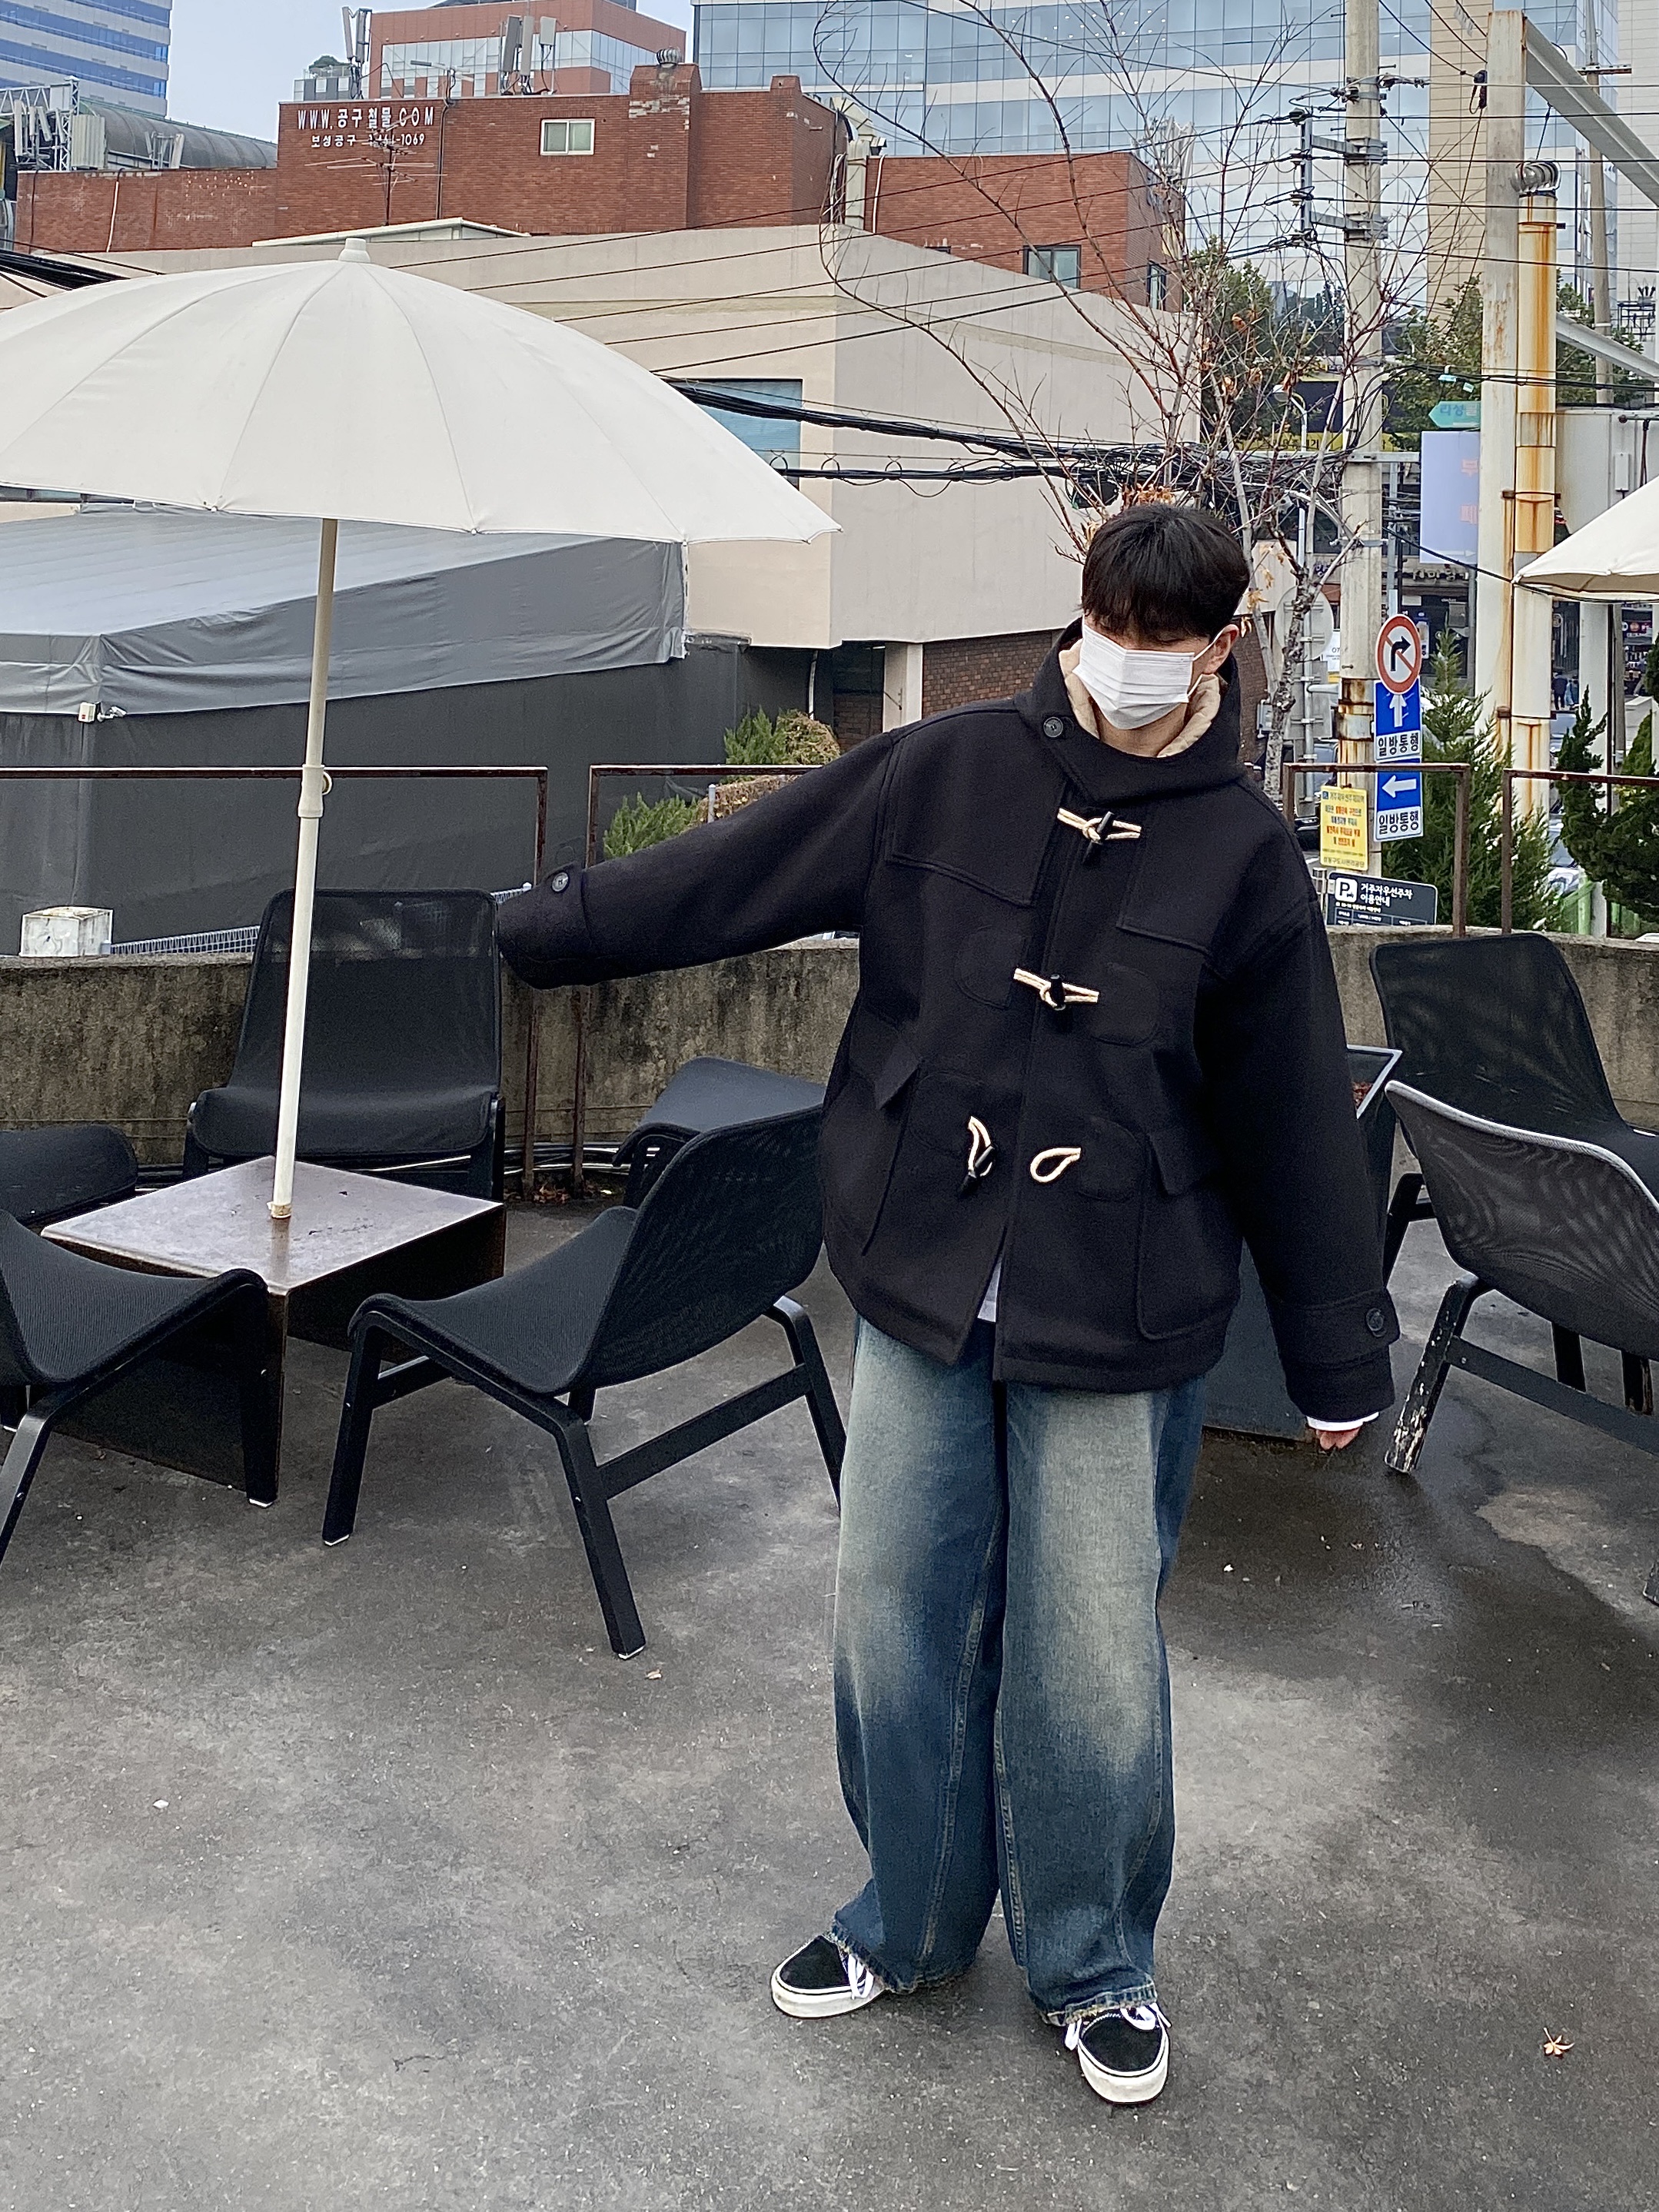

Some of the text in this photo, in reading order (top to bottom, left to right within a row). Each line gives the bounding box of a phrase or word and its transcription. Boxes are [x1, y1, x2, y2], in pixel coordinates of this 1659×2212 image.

[298, 106, 434, 130] WWW.공구철물COM
[311, 134, 357, 148] 보성공구
[1378, 732, 1419, 757] 일방통행
[1378, 810, 1419, 835] 일방통행
[1360, 892, 1391, 907] 이용안내
